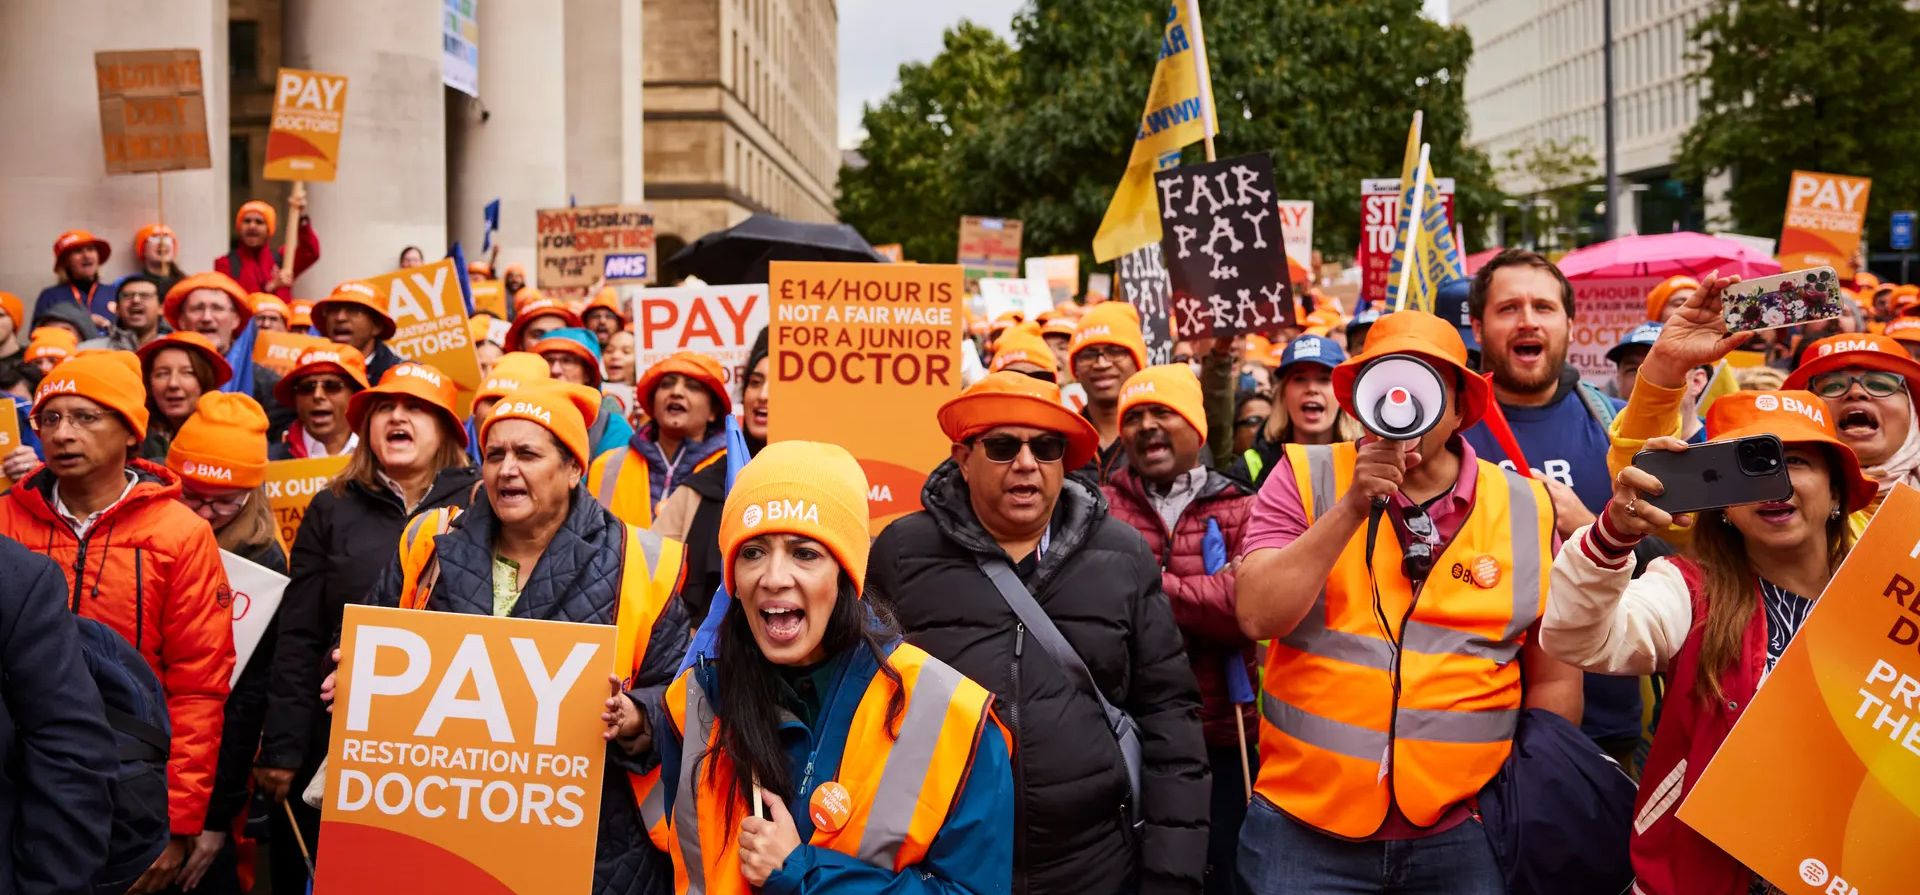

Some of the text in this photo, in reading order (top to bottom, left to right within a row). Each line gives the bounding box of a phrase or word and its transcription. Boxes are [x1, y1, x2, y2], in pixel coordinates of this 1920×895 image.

[279, 74, 344, 111] PAY
[1158, 165, 1271, 219] FAIR
[1792, 176, 1866, 212] PAY
[537, 213, 577, 234] PAY
[1173, 208, 1270, 259] PAY
[543, 234, 576, 249] FOR
[1365, 225, 1397, 254] TO
[604, 255, 646, 278] NHS
[1121, 242, 1166, 280] FAIR
[387, 266, 449, 322] AY
[780, 278, 953, 304] £14/HOUR IS
[1125, 280, 1166, 319] PAY
[641, 295, 759, 350] PAY
[777, 304, 952, 326] NOT A FAIR WAGE
[1176, 282, 1285, 336] X-RAY
[388, 327, 467, 361] CTORS
[779, 326, 952, 351] FOR A JUNIOR
[1834, 339, 1880, 353] BMA
[411, 366, 441, 388] BMA
[778, 351, 951, 386] DOCTOR
[42, 379, 77, 396] BMA
[513, 401, 552, 425] BMA
[1782, 396, 1825, 427] BMA
[198, 463, 232, 481] BMA
[264, 480, 282, 498] IX
[867, 485, 893, 502] MA
[767, 499, 819, 526] BMA
[345, 624, 601, 746] PAY
[1865, 658, 1920, 710] PR
[342, 738, 590, 778] RESTORATION FOR
[336, 768, 586, 827] DOCTORS
[823, 796, 839, 815] NOW
[831, 786, 846, 801] PAY
